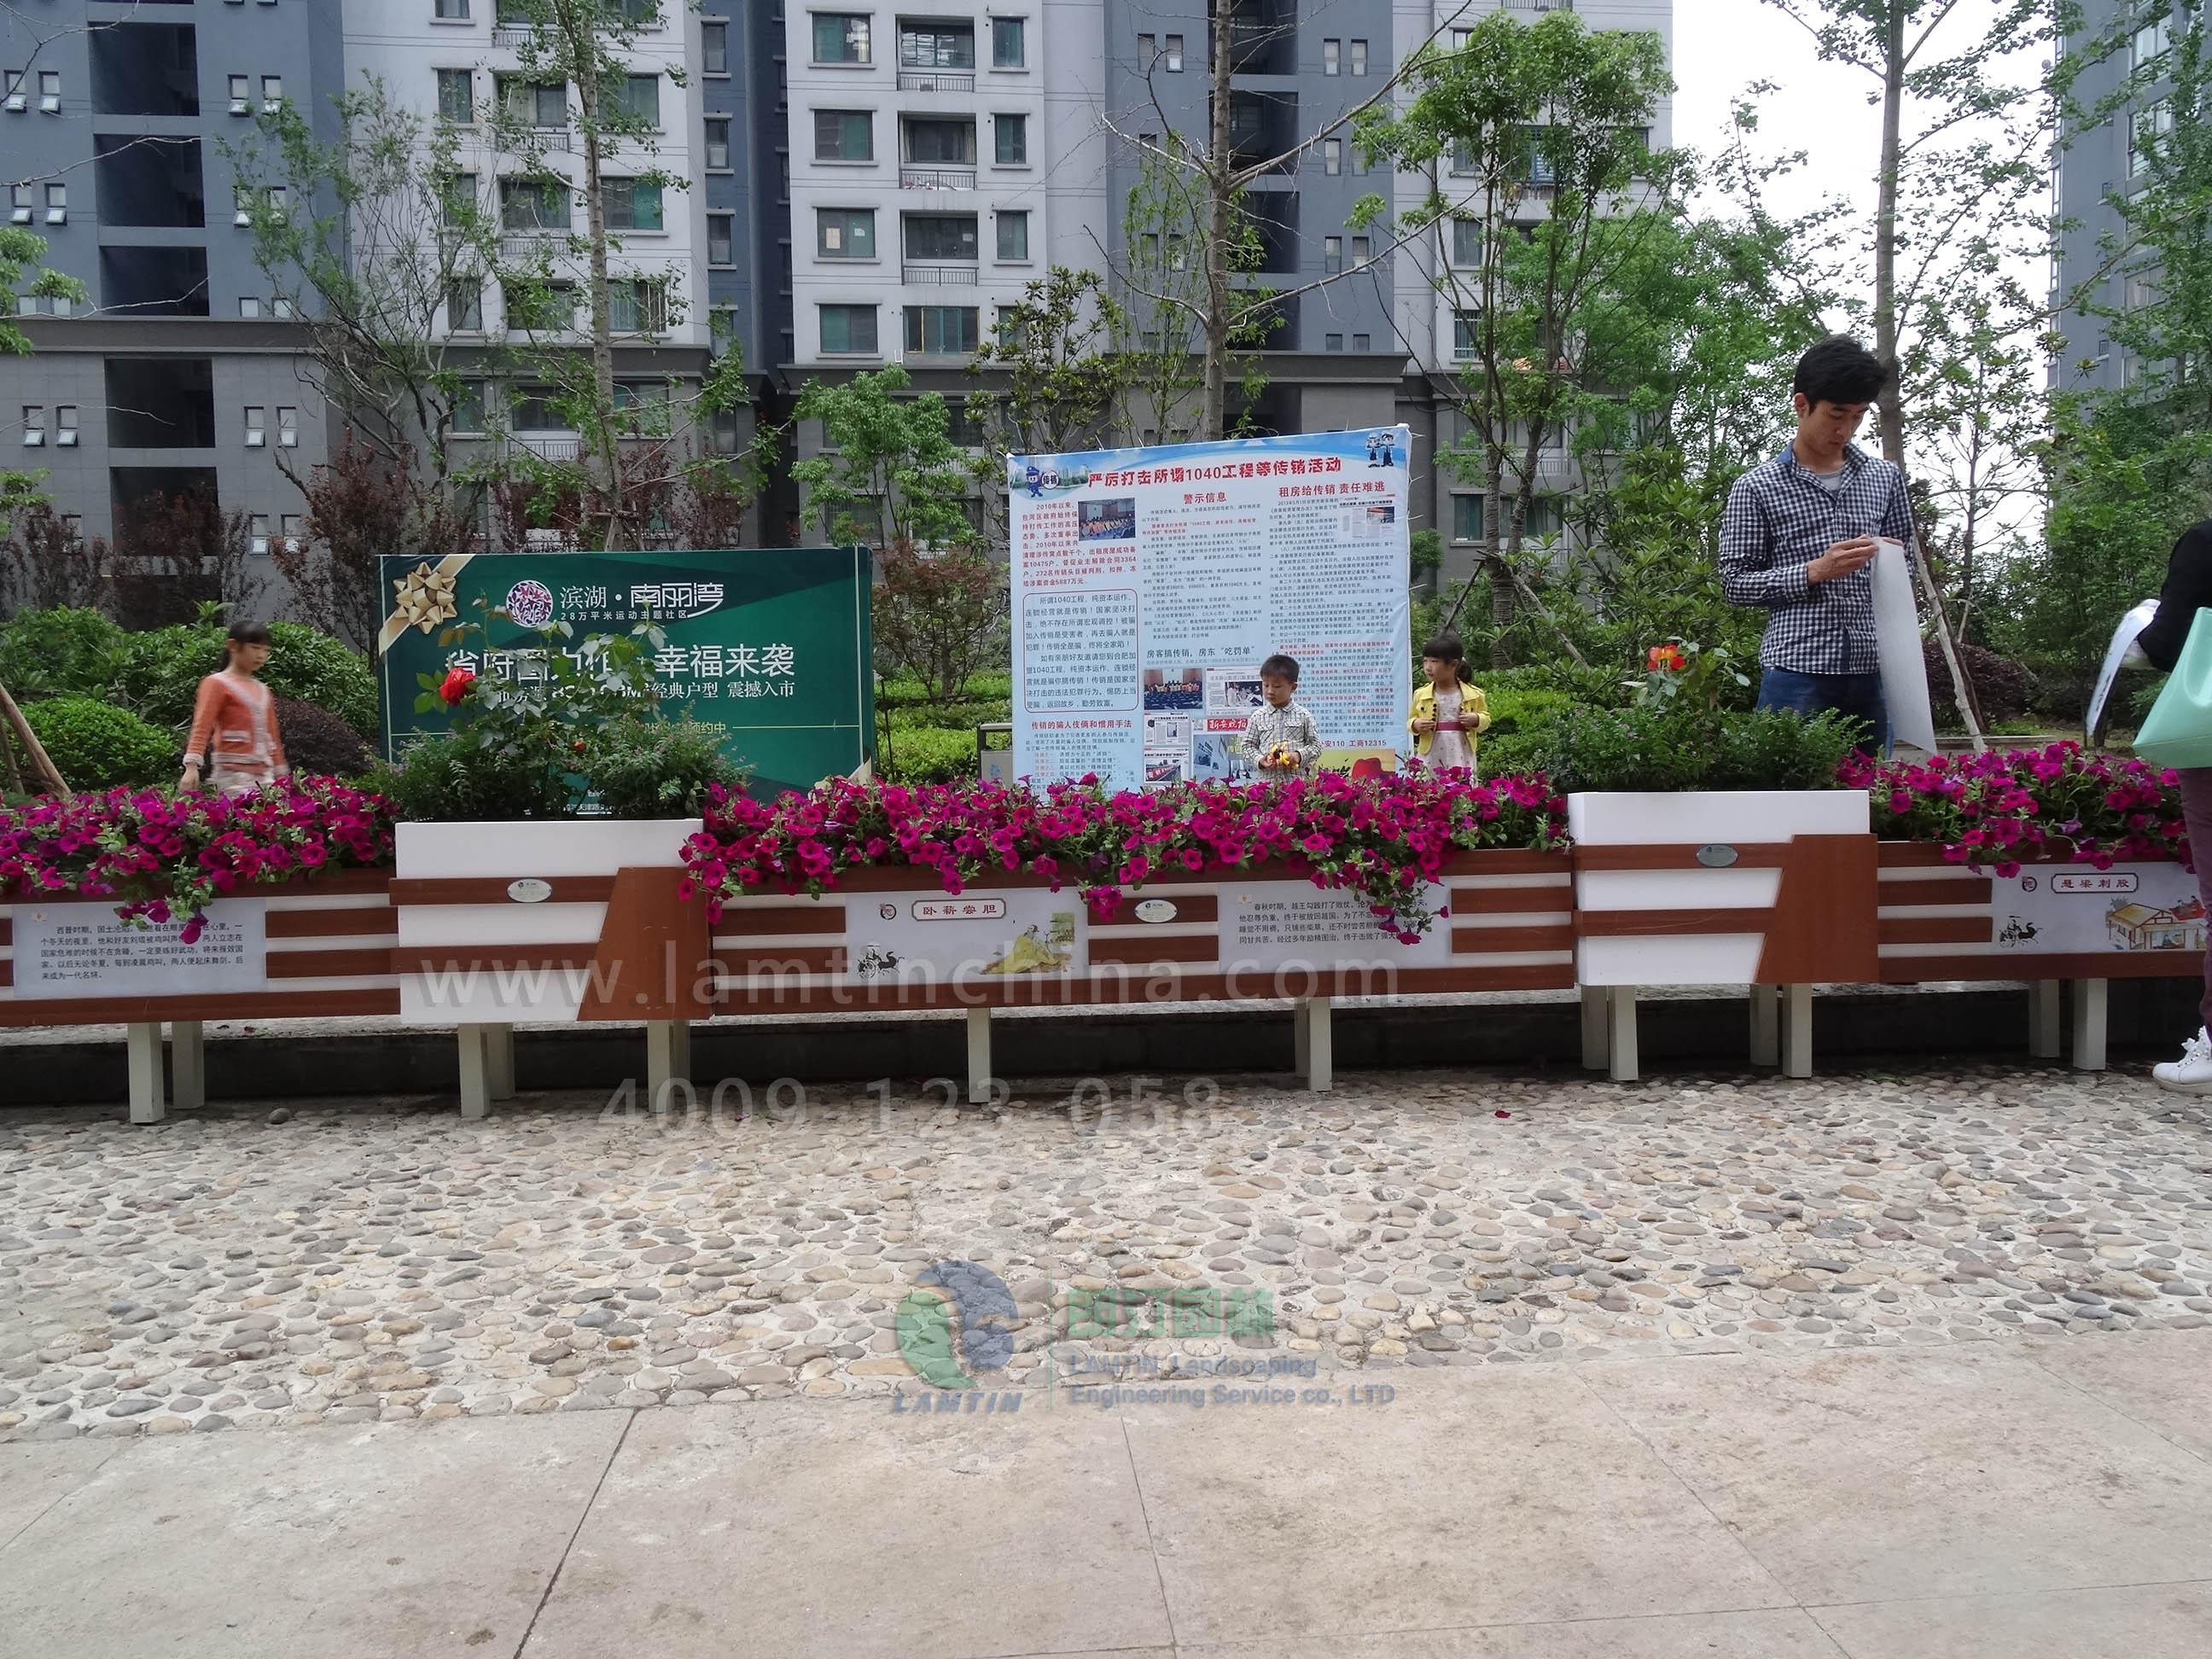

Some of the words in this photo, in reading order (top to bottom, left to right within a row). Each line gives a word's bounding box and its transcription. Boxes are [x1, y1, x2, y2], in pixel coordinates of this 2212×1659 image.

[1088, 457, 1341, 488] 严厉打击所谓1040工程等传销活动
[1278, 485, 1336, 498] 租房给传销
[1339, 481, 1386, 494] 责任难逃
[1184, 491, 1227, 504] 警示信息
[560, 609, 689, 620] 28万平米运动主题社区
[655, 643, 795, 679] 幸福来袭
[726, 680, 795, 699] 震撼入市
[1031, 719, 1132, 731] 传销的骗人伎俩和惯用手法
[1321, 740, 1345, 748] 安110
[1349, 739, 1387, 748] 工商12315
[923, 905, 997, 915] 卧薪尝胆
